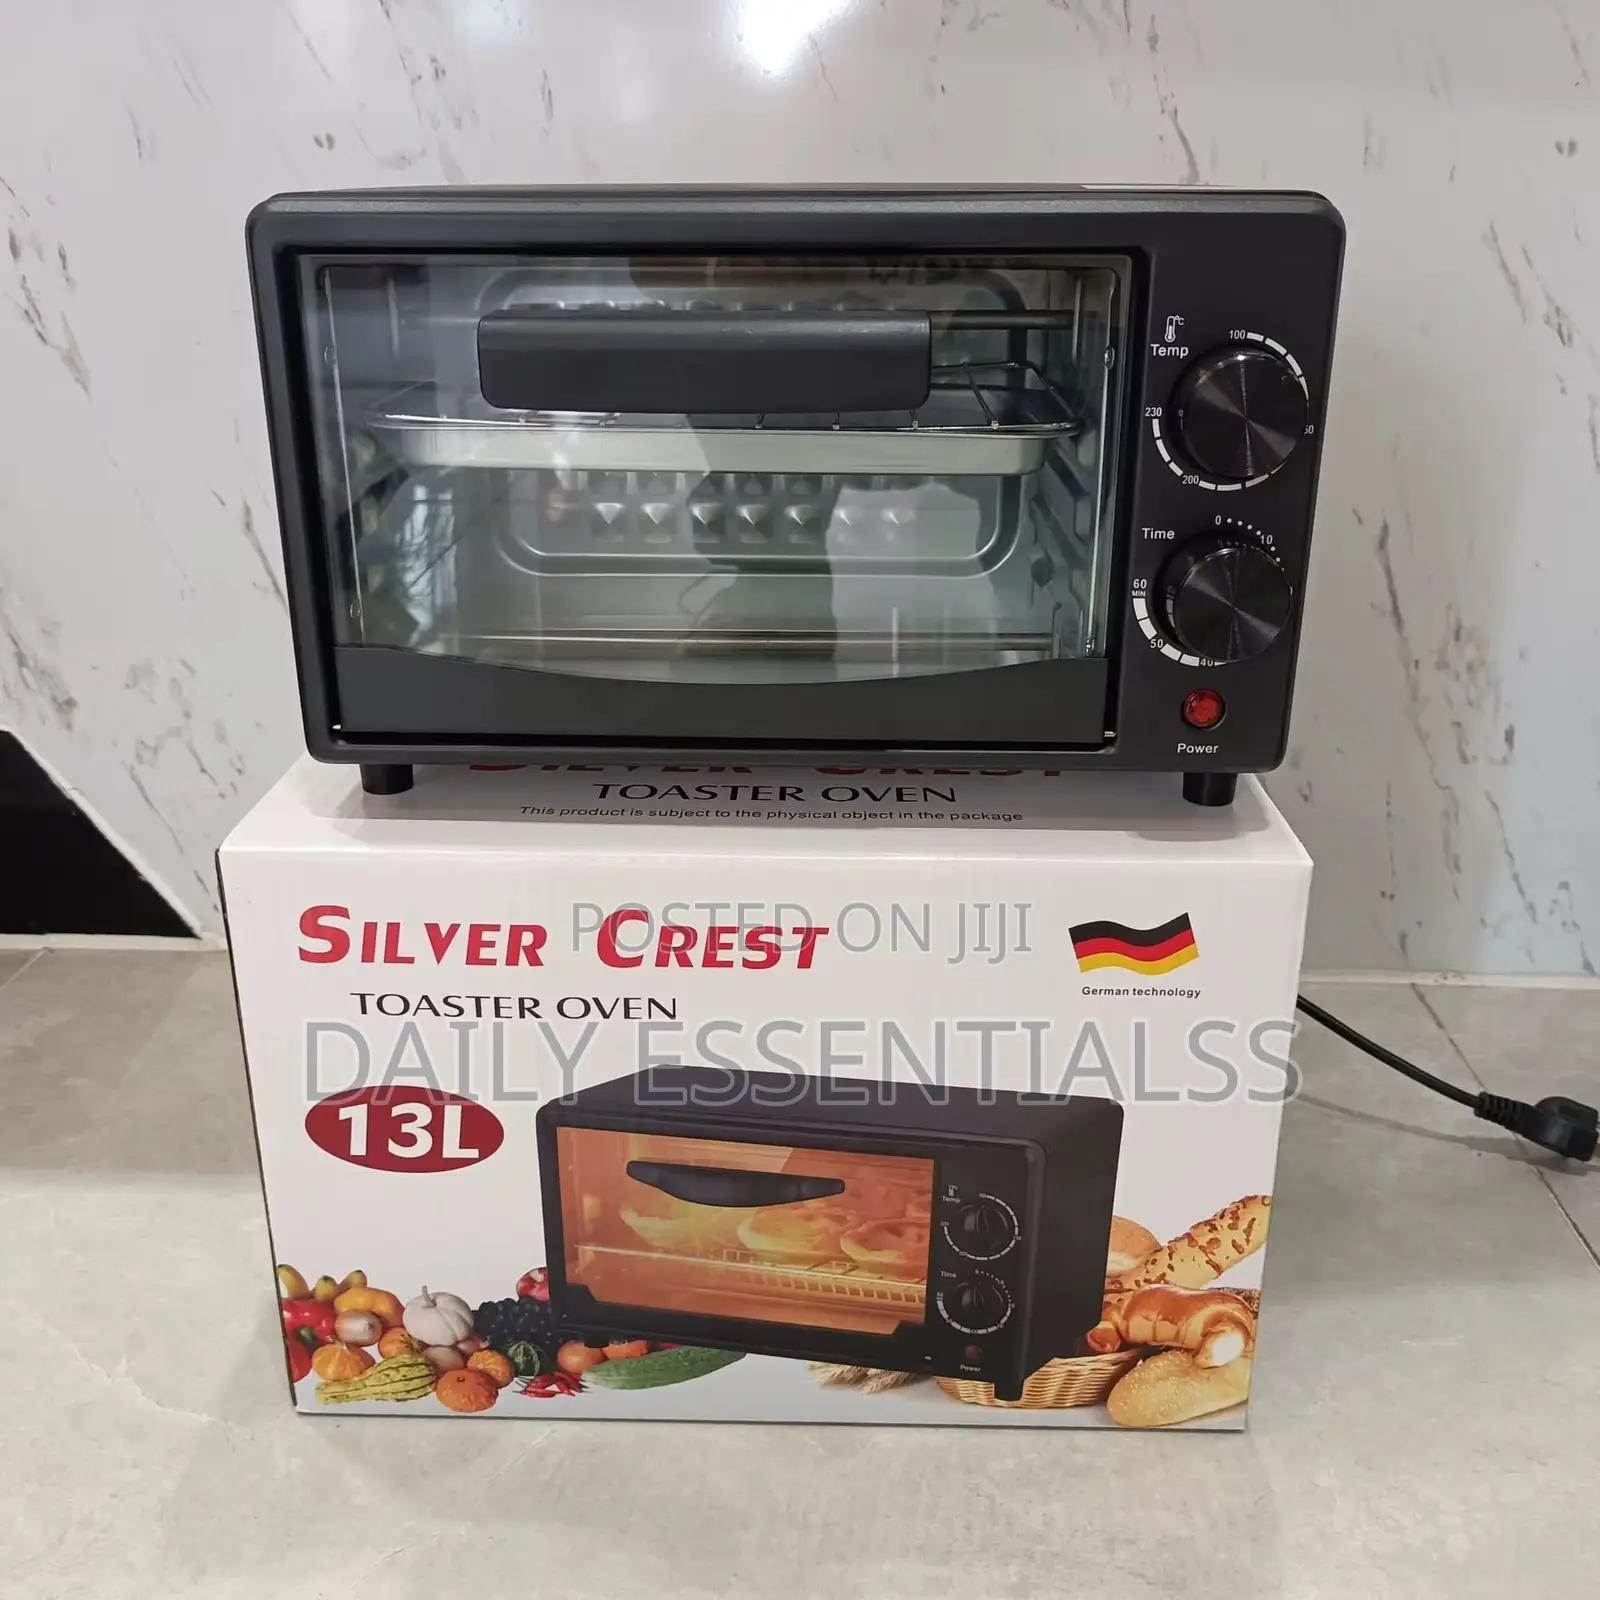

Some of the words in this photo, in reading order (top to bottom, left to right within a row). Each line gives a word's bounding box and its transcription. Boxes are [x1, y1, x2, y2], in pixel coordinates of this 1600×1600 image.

[1229, 330, 1246, 340] 100
[1150, 344, 1189, 359] Temp
[1145, 407, 1162, 418] 230
[1182, 475, 1199, 486] 200
[1215, 515, 1222, 526] 0
[1142, 528, 1175, 540] Time
[1260, 534, 1274, 545] 10
[1133, 579, 1147, 589] 60
[1150, 638, 1164, 649] 50
[1177, 743, 1219, 755] Power
[593, 783, 805, 802] TOASTER
[821, 786, 957, 803] OVEN
[520, 806, 555, 816] This
[559, 807, 626, 817] product
[630, 808, 643, 816] is
[649, 808, 711, 819] subject
[715, 809, 730, 818] to
[736, 810, 761, 818] the
[767, 810, 837, 820] physical
[842, 811, 893, 820] object
[899, 811, 913, 820] in
[918, 811, 945, 821] the
[950, 811, 1023, 822] package
[298, 904, 548, 967] SILVER
[597, 909, 830, 970] CREST
[1082, 986, 1129, 996] German
[1132, 987, 1201, 999] technology
[350, 992, 543, 1019] TOASTER
[556, 995, 677, 1021] OVEN
[337, 1102, 480, 1159] 13L
